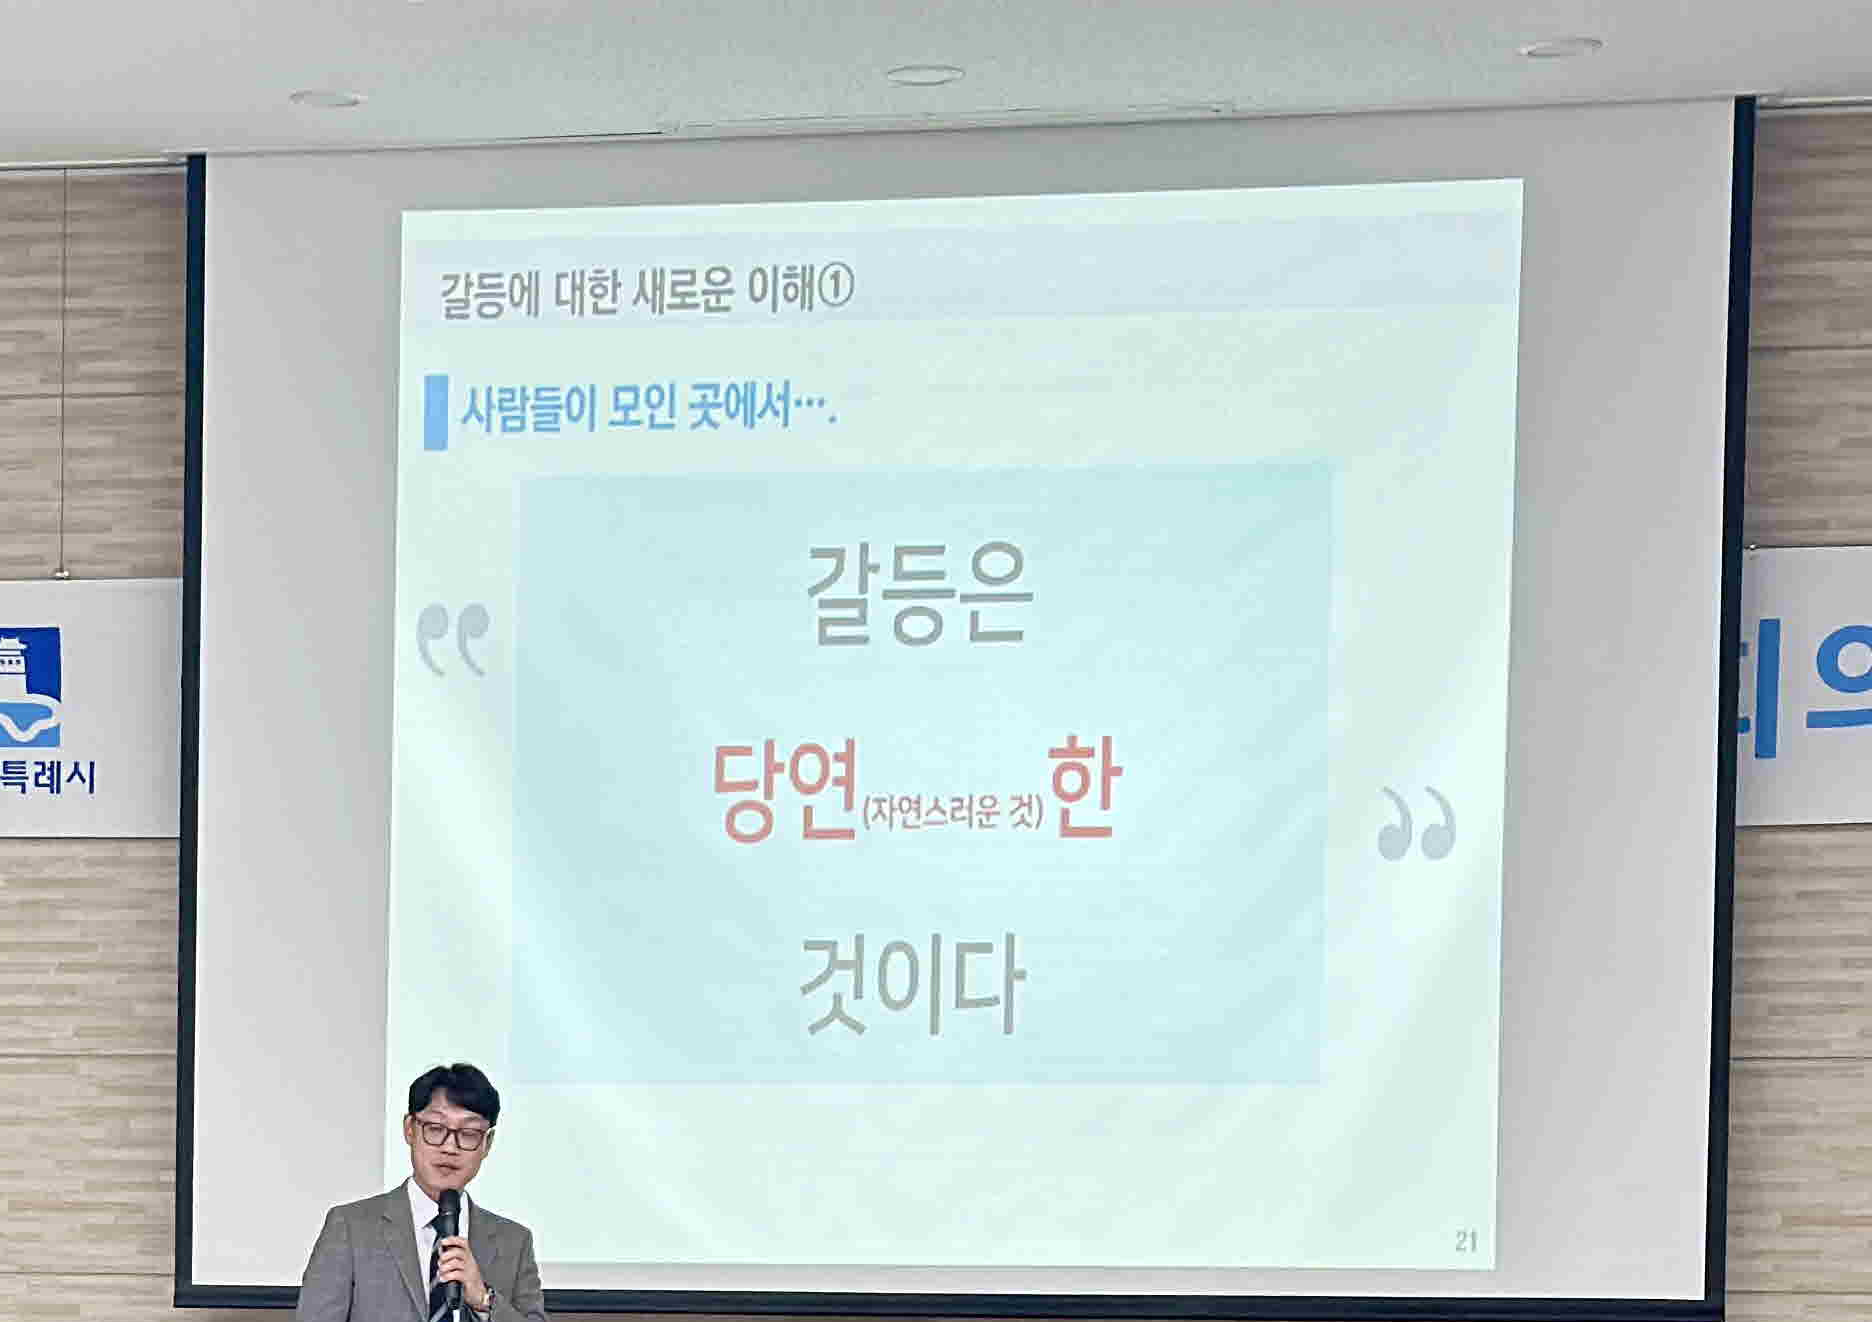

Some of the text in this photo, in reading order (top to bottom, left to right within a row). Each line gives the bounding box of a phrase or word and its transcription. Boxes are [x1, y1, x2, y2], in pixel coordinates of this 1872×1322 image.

[440, 268, 540, 320] 갈등에
[554, 267, 622, 317] 대한
[631, 265, 736, 315] 새로운
[461, 383, 597, 434] 사람들이
[607, 380, 677, 430] 모인
[807, 540, 1034, 647] 갈등은
[799, 931, 1028, 1036] 것이다
[1455, 1228, 1479, 1253] 21
